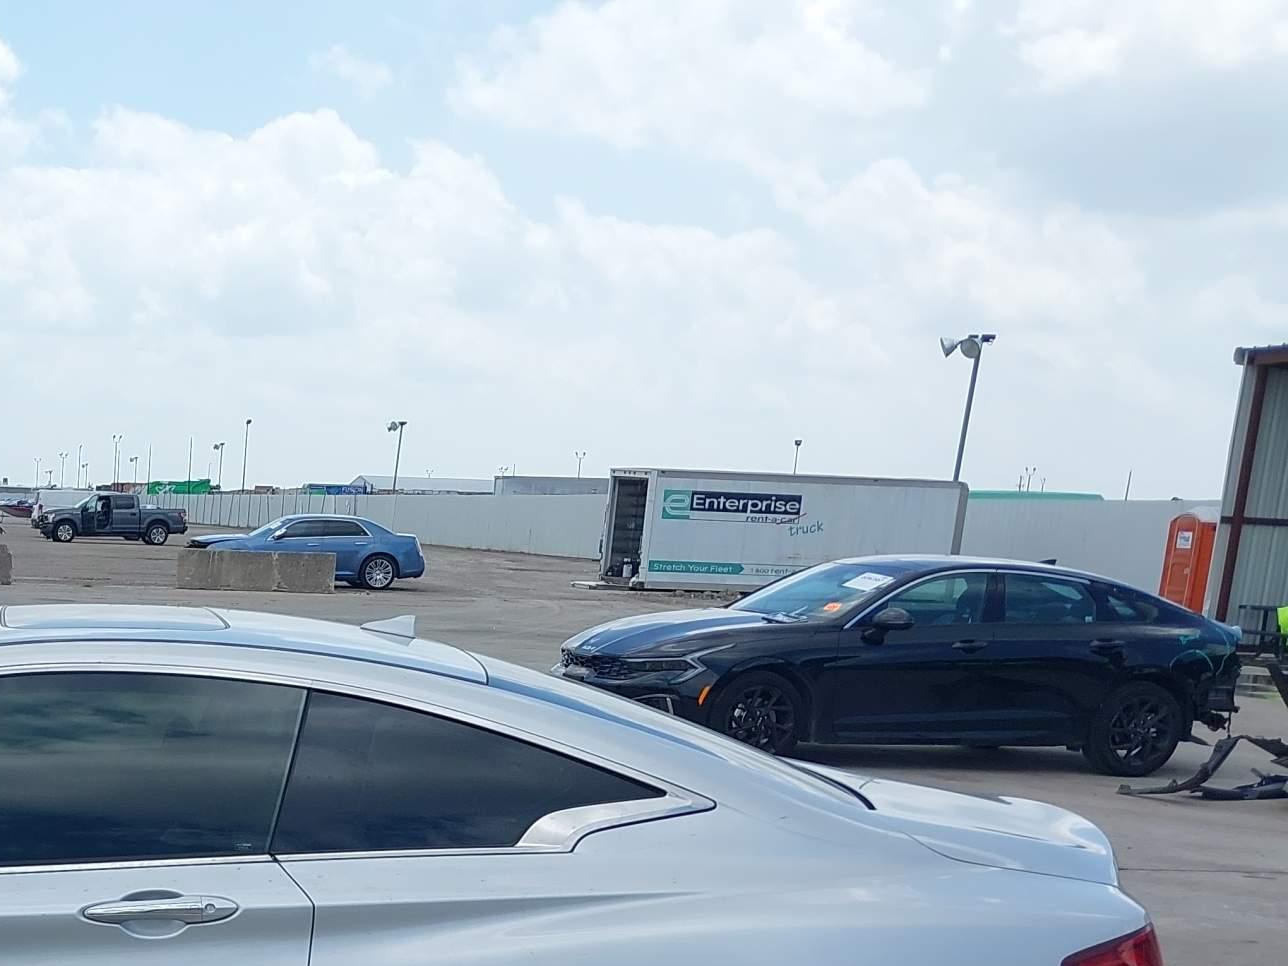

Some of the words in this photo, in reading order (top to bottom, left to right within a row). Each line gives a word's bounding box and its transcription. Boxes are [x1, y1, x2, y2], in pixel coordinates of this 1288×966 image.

[692, 494, 800, 514] Enterprise
[745, 514, 798, 525] rent-a-car
[788, 520, 824, 536] truck
[653, 563, 685, 572] Stretch
[688, 564, 709, 573] Your
[710, 565, 733, 573] Fleet
